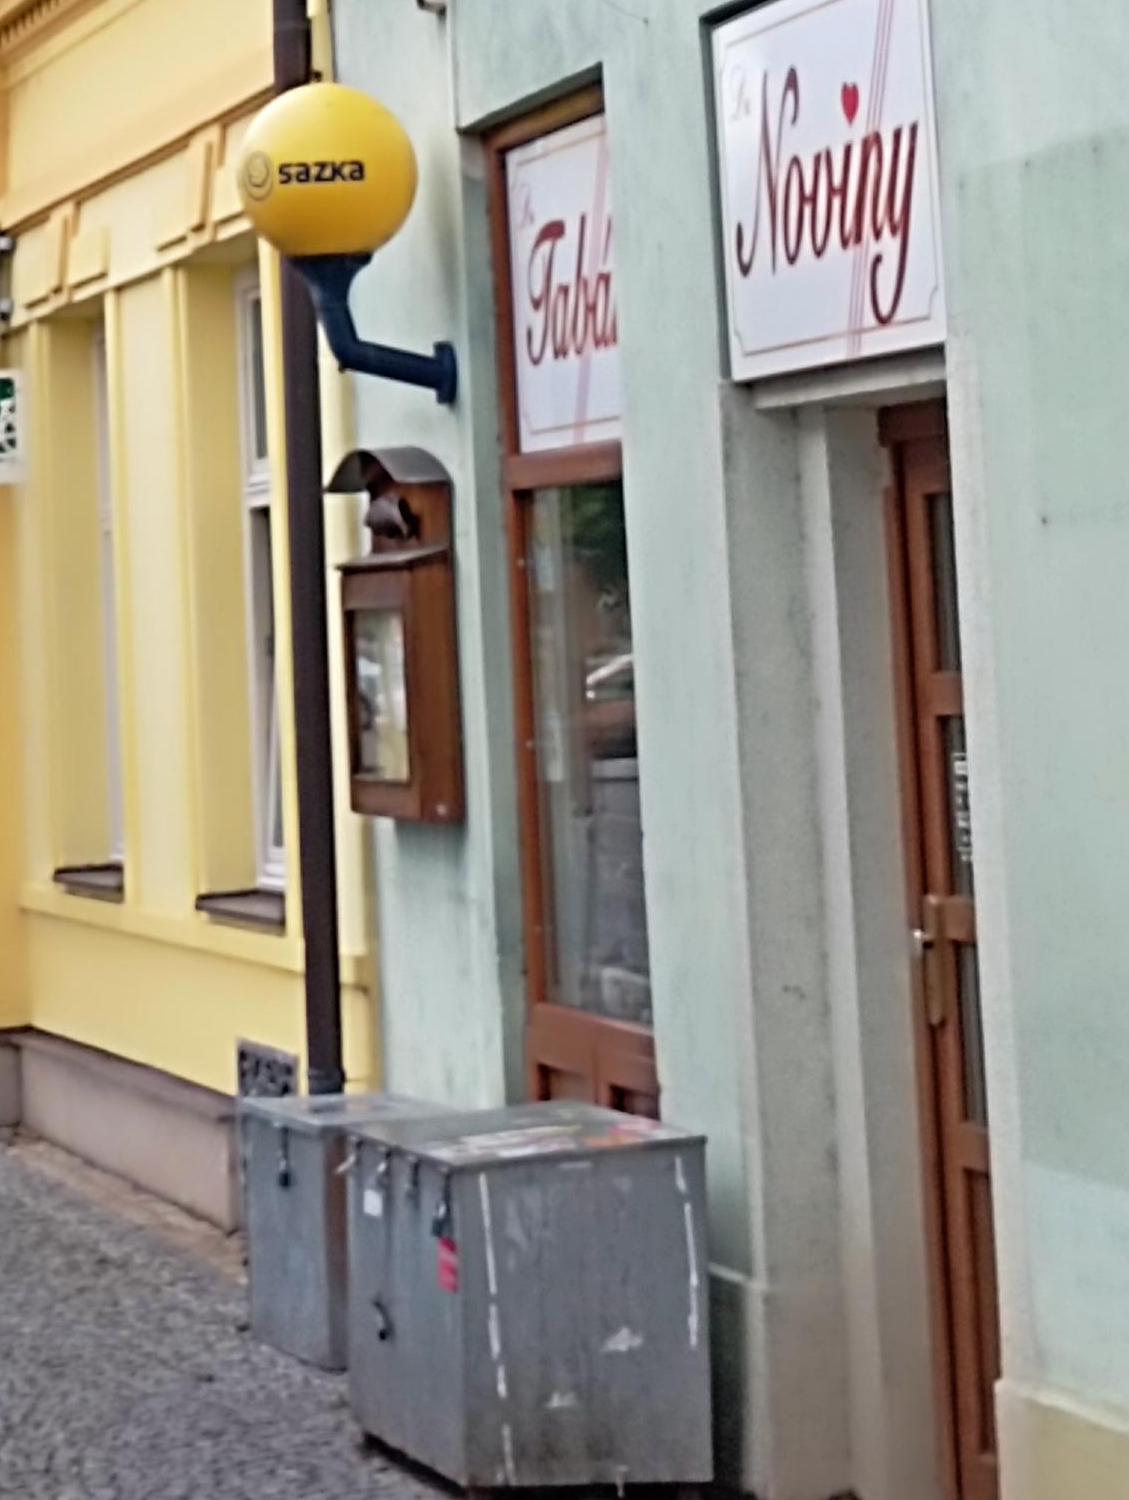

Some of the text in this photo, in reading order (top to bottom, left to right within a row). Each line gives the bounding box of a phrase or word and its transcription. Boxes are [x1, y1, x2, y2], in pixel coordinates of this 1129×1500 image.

[278, 159, 366, 185] sazka
[737, 64, 919, 326] Noviny
[526, 211, 618, 366] Tabá
